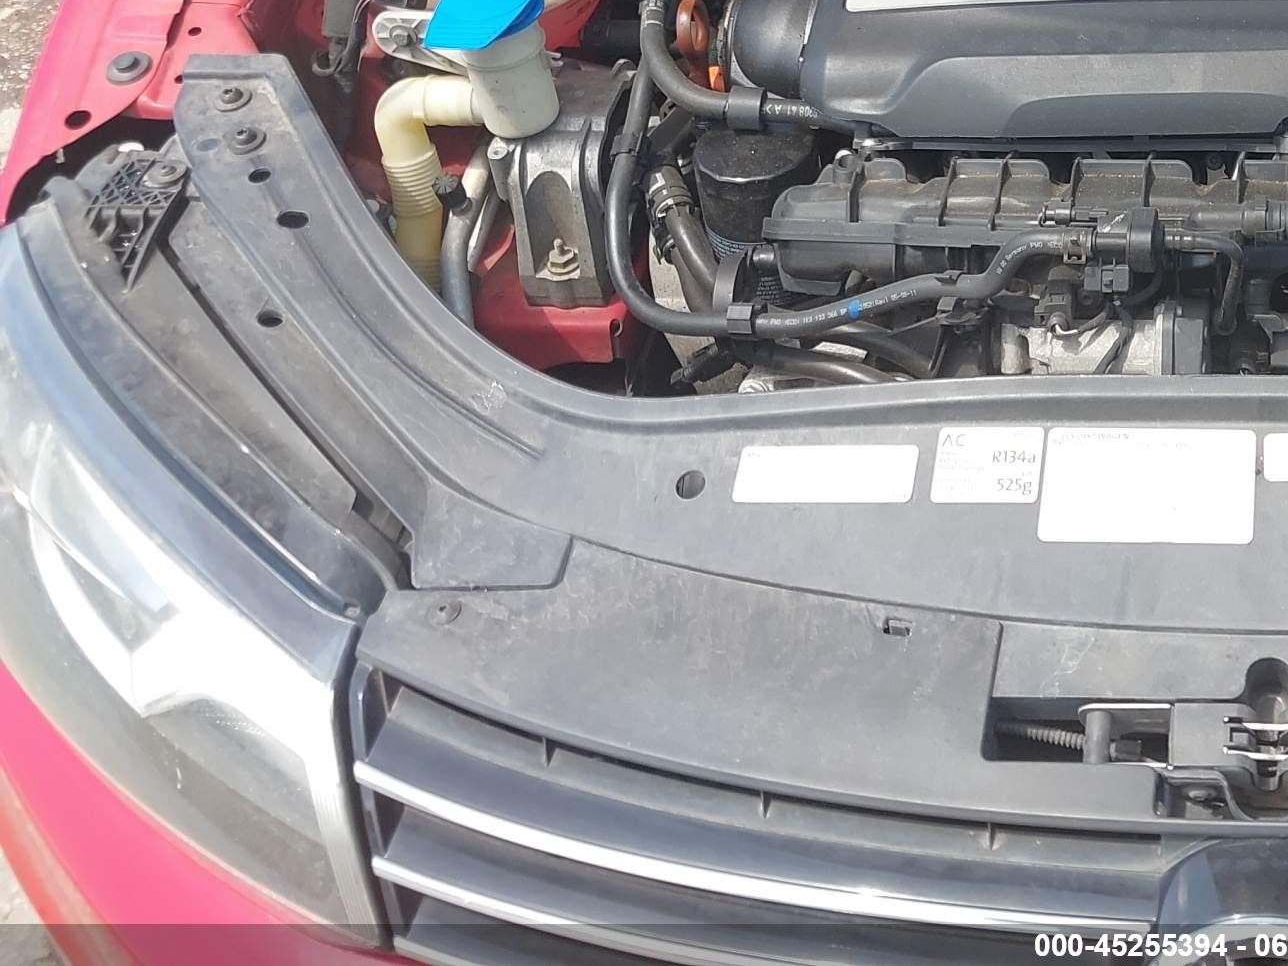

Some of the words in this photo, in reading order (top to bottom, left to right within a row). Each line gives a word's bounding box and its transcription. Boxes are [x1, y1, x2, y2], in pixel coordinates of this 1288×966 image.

[942, 434, 967, 447] AC
[992, 450, 1037, 464] R134a
[997, 478, 1032, 495] 525g
